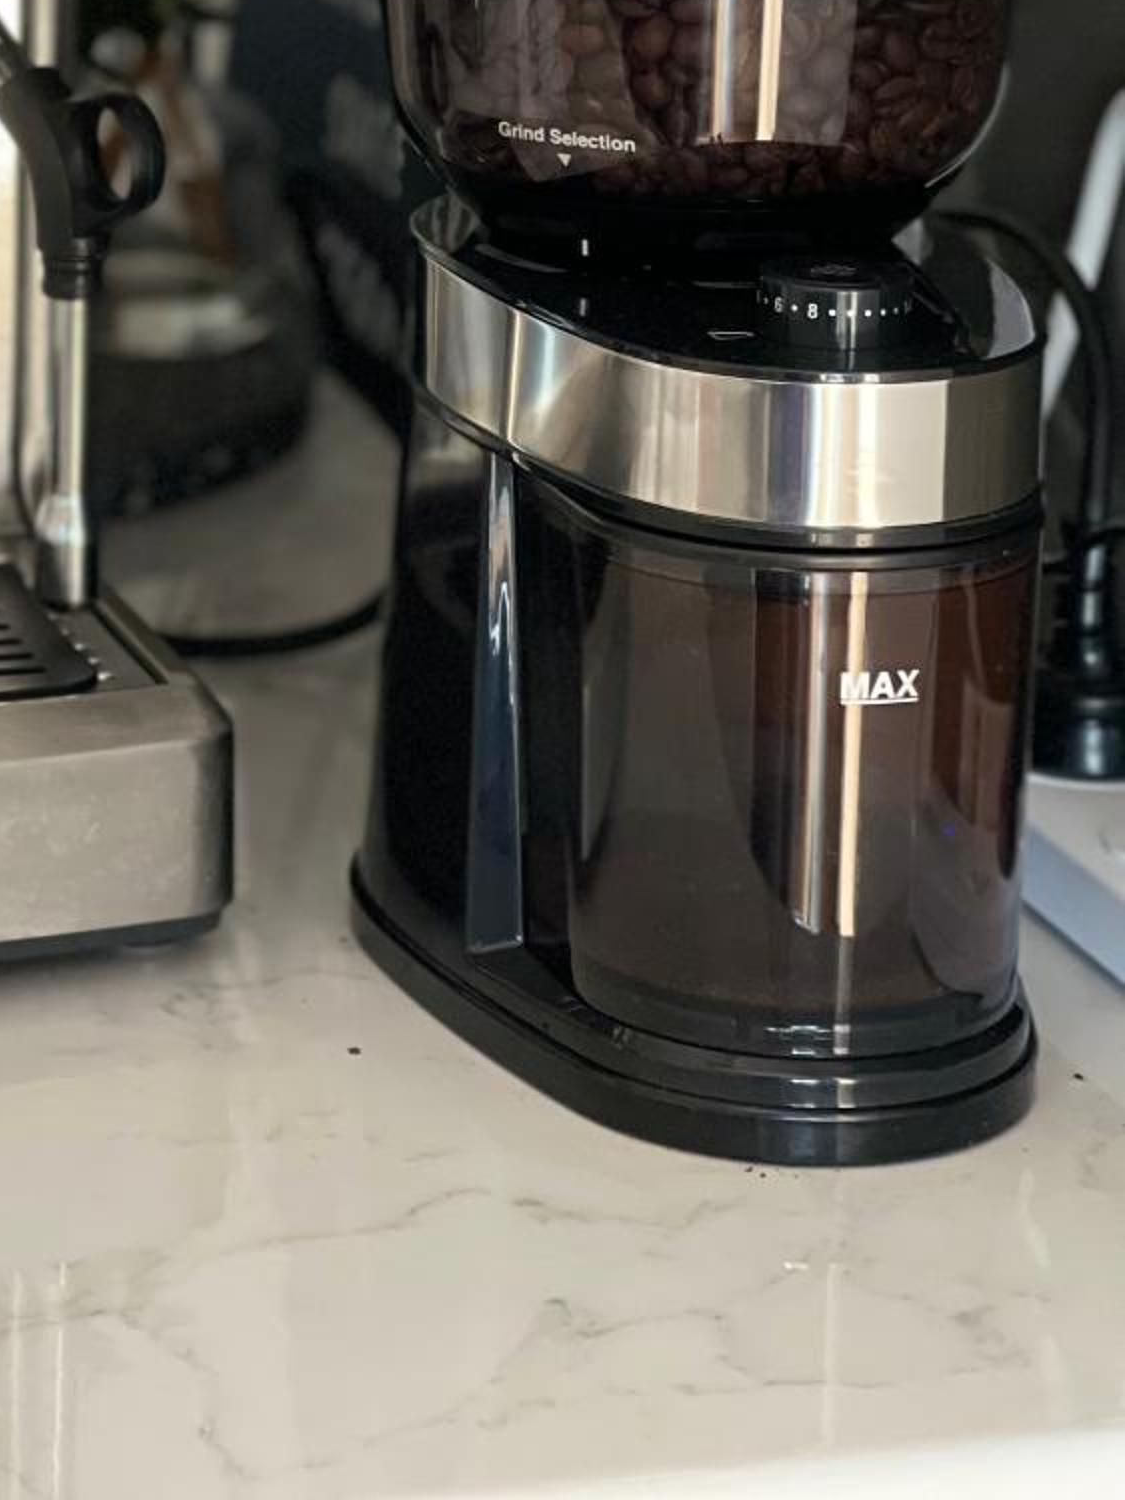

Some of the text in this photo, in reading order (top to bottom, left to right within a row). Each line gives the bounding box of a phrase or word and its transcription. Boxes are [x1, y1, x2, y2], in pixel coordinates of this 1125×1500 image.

[498, 121, 636, 152] Grind Selection
[807, 303, 818, 319] 8
[840, 669, 920, 699] MAX
